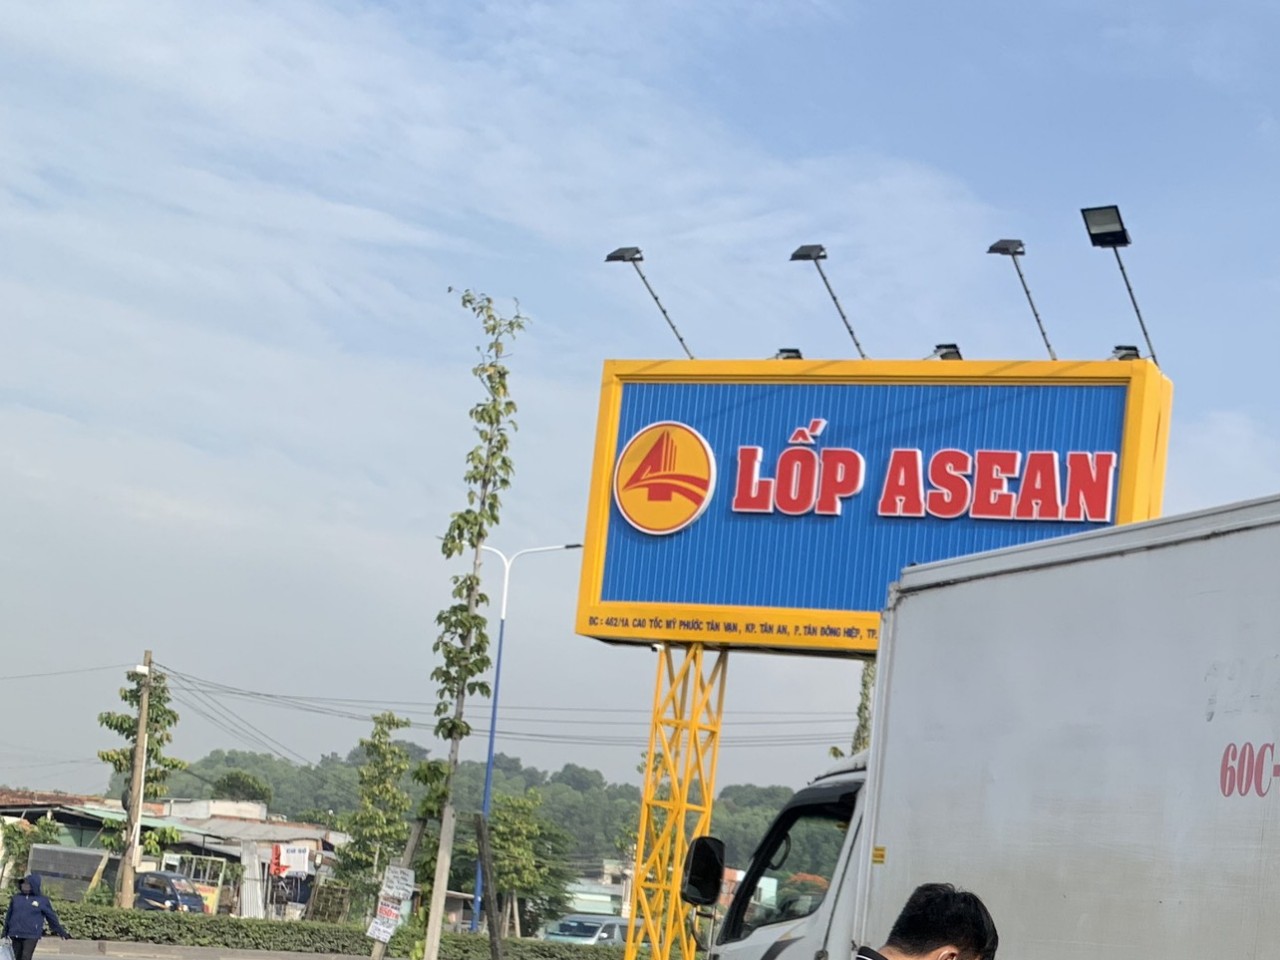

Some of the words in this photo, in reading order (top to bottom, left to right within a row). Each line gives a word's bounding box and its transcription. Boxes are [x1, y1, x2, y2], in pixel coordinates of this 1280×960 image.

[732, 418, 865, 516] LỐP
[878, 448, 1116, 522] ASEAN
[650, 616, 663, 629] TỐC
